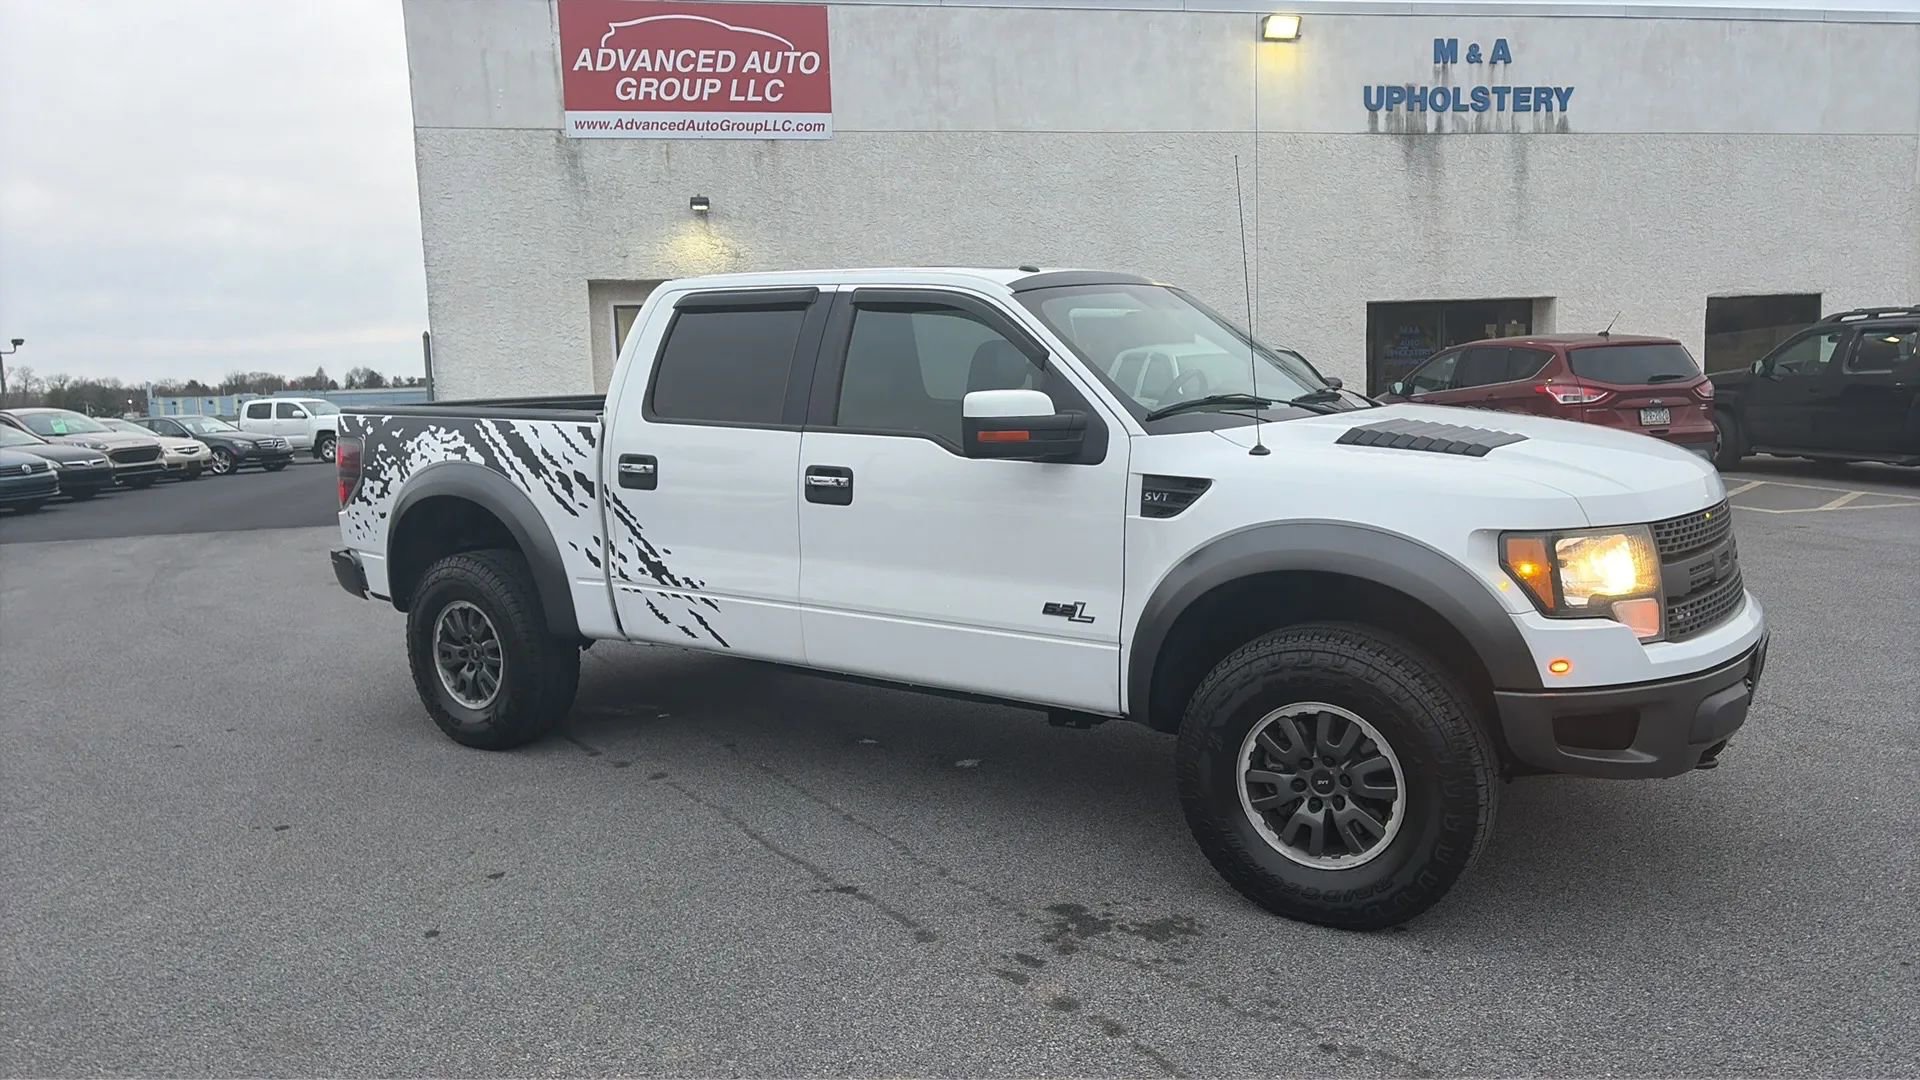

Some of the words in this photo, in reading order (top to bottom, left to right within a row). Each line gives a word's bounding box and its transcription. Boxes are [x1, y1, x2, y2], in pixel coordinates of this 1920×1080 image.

[573, 48, 736, 73] ADVANCED
[742, 51, 820, 74] AUTO
[1433, 38, 1458, 64] M
[1466, 43, 1482, 64] &
[1490, 38, 1512, 64] A
[615, 77, 721, 101] GROUP
[730, 79, 784, 102] LLC
[1363, 86, 1575, 112] UPHOLSTERY
[574, 118, 826, 134] www.AdvancedAutoGroupLLC.com
[1144, 492, 1169, 502] SVT
